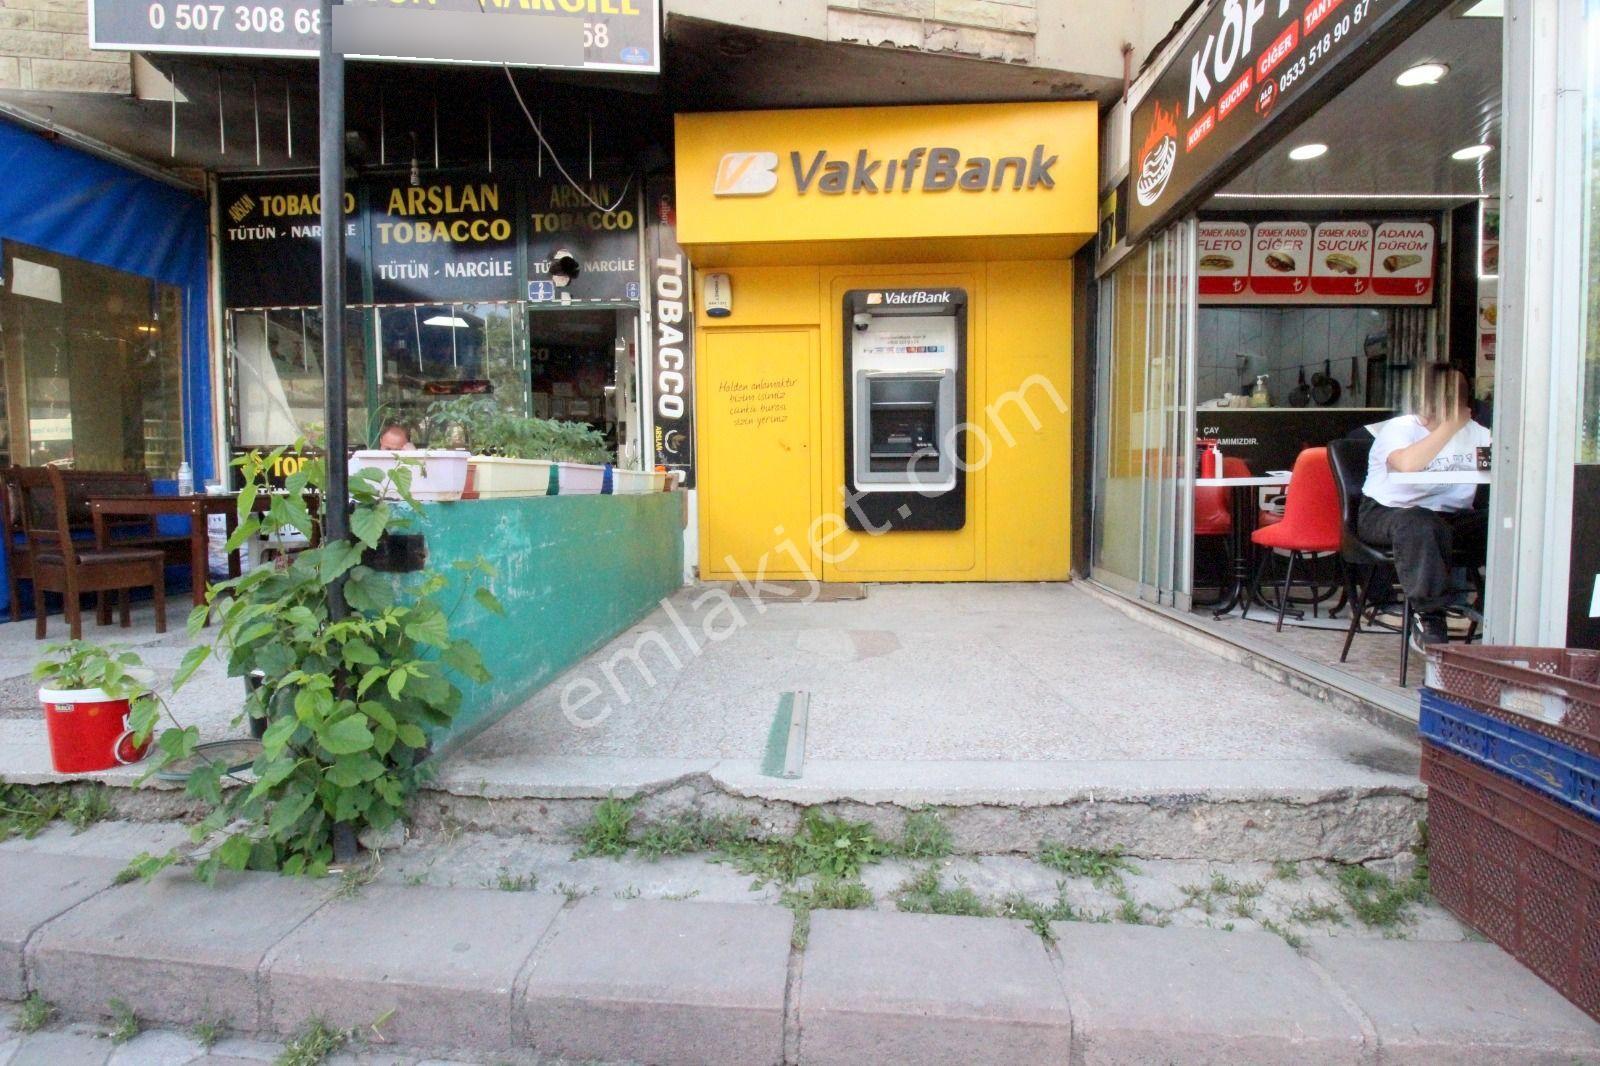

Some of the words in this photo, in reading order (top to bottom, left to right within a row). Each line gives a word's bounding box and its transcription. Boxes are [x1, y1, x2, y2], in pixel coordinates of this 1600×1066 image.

[149, 4, 165, 30] 0
[175, 5, 223, 32] 507
[234, 6, 285, 34] 308
[1187, 0, 1290, 119] KÖF
[1261, 34, 1292, 74] CİĞER
[1279, 57, 1306, 92] 0533
[1308, 33, 1331, 66] 518
[1334, 15, 1350, 43] 90
[1219, 75, 1249, 113] SUCUK
[790, 145, 1060, 196] VakıfBank
[259, 192, 355, 217] TOBACO
[387, 184, 499, 216] ARSLAN
[377, 218, 511, 245] TOBACCO
[531, 210, 634, 232] TOBACCO
[228, 225, 276, 241] TÜTÜN
[1224, 229, 1247, 237] ARASI
[1257, 229, 1283, 237] EKMEK
[1284, 229, 1308, 237] ARASI
[1319, 229, 1344, 238] EKMEK
[1346, 229, 1369, 238] ARASI
[1378, 230, 1424, 238] ADANA
[1317, 240, 1369, 251] SUCUK
[1377, 240, 1428, 251] DÜRÜM
[378, 261, 428, 280] TÜTÜN
[444, 257, 513, 279] NARGİLE
[584, 257, 635, 273] NARGİLE
[884, 291, 951, 305] VakıfBank
[656, 253, 685, 420] TOBACCO
